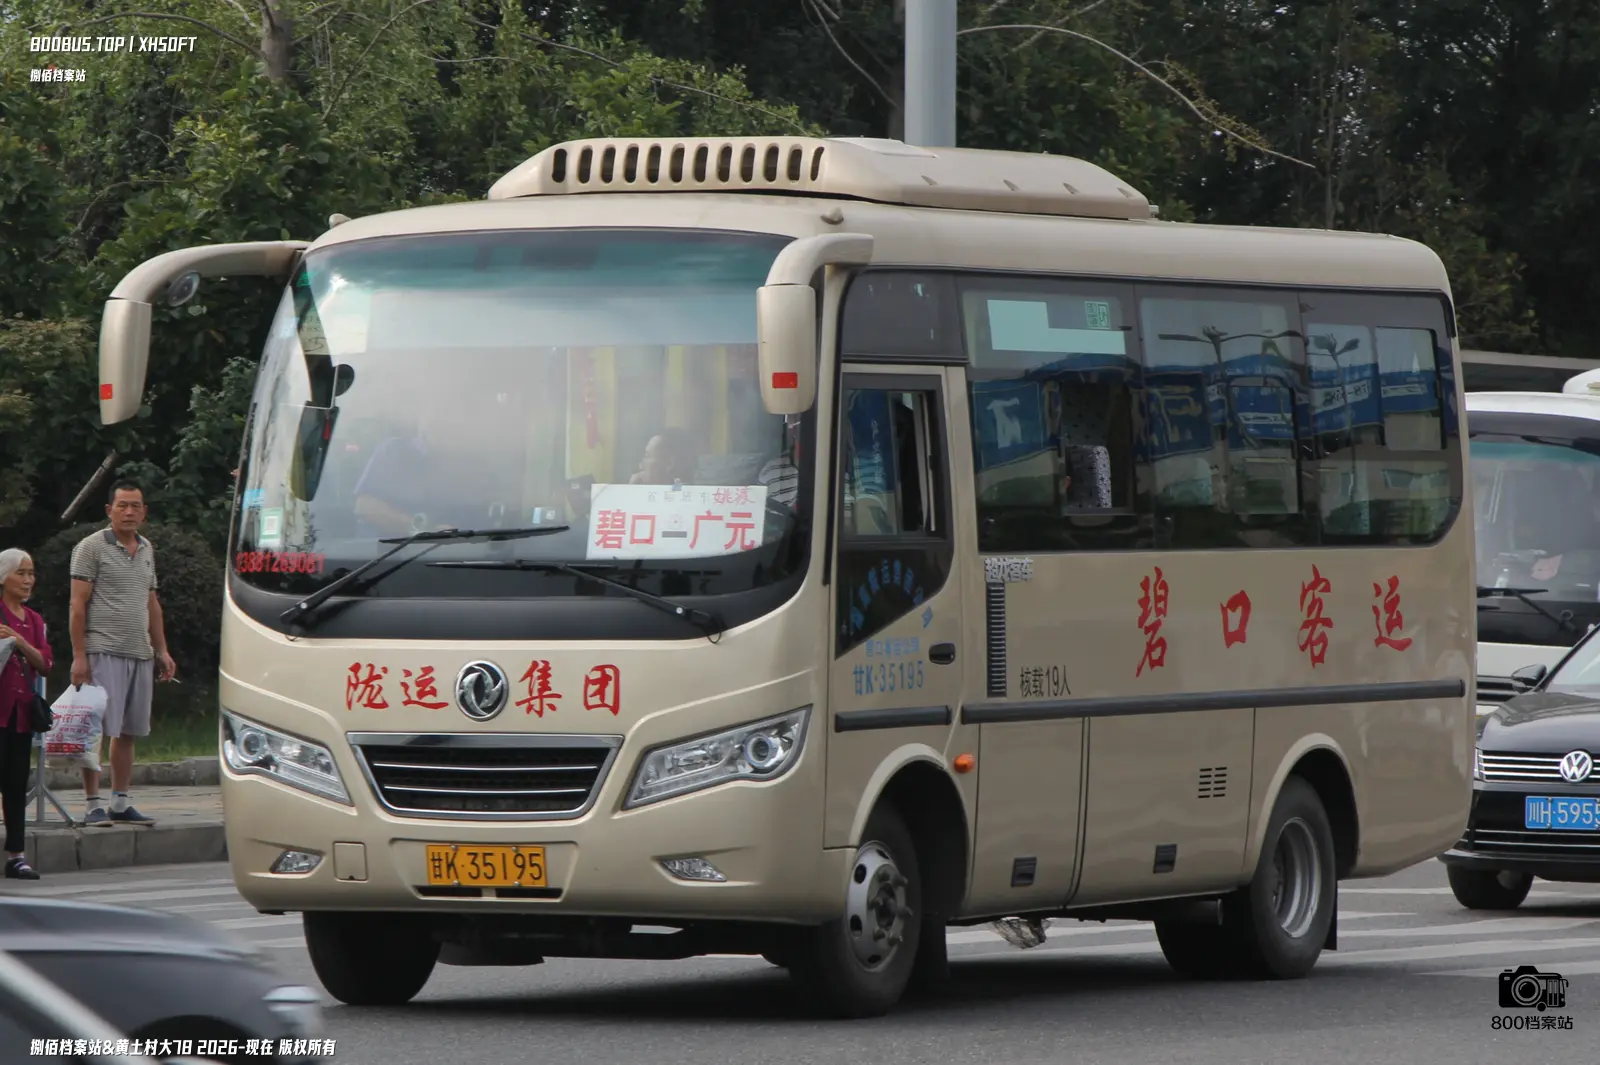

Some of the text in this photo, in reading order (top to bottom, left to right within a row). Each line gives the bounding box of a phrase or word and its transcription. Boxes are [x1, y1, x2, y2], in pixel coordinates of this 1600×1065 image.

[1135, 563, 1413, 678] 碧口客运
[346, 659, 621, 718] 陇运集团
[1020, 665, 1071, 698] 核载19人
